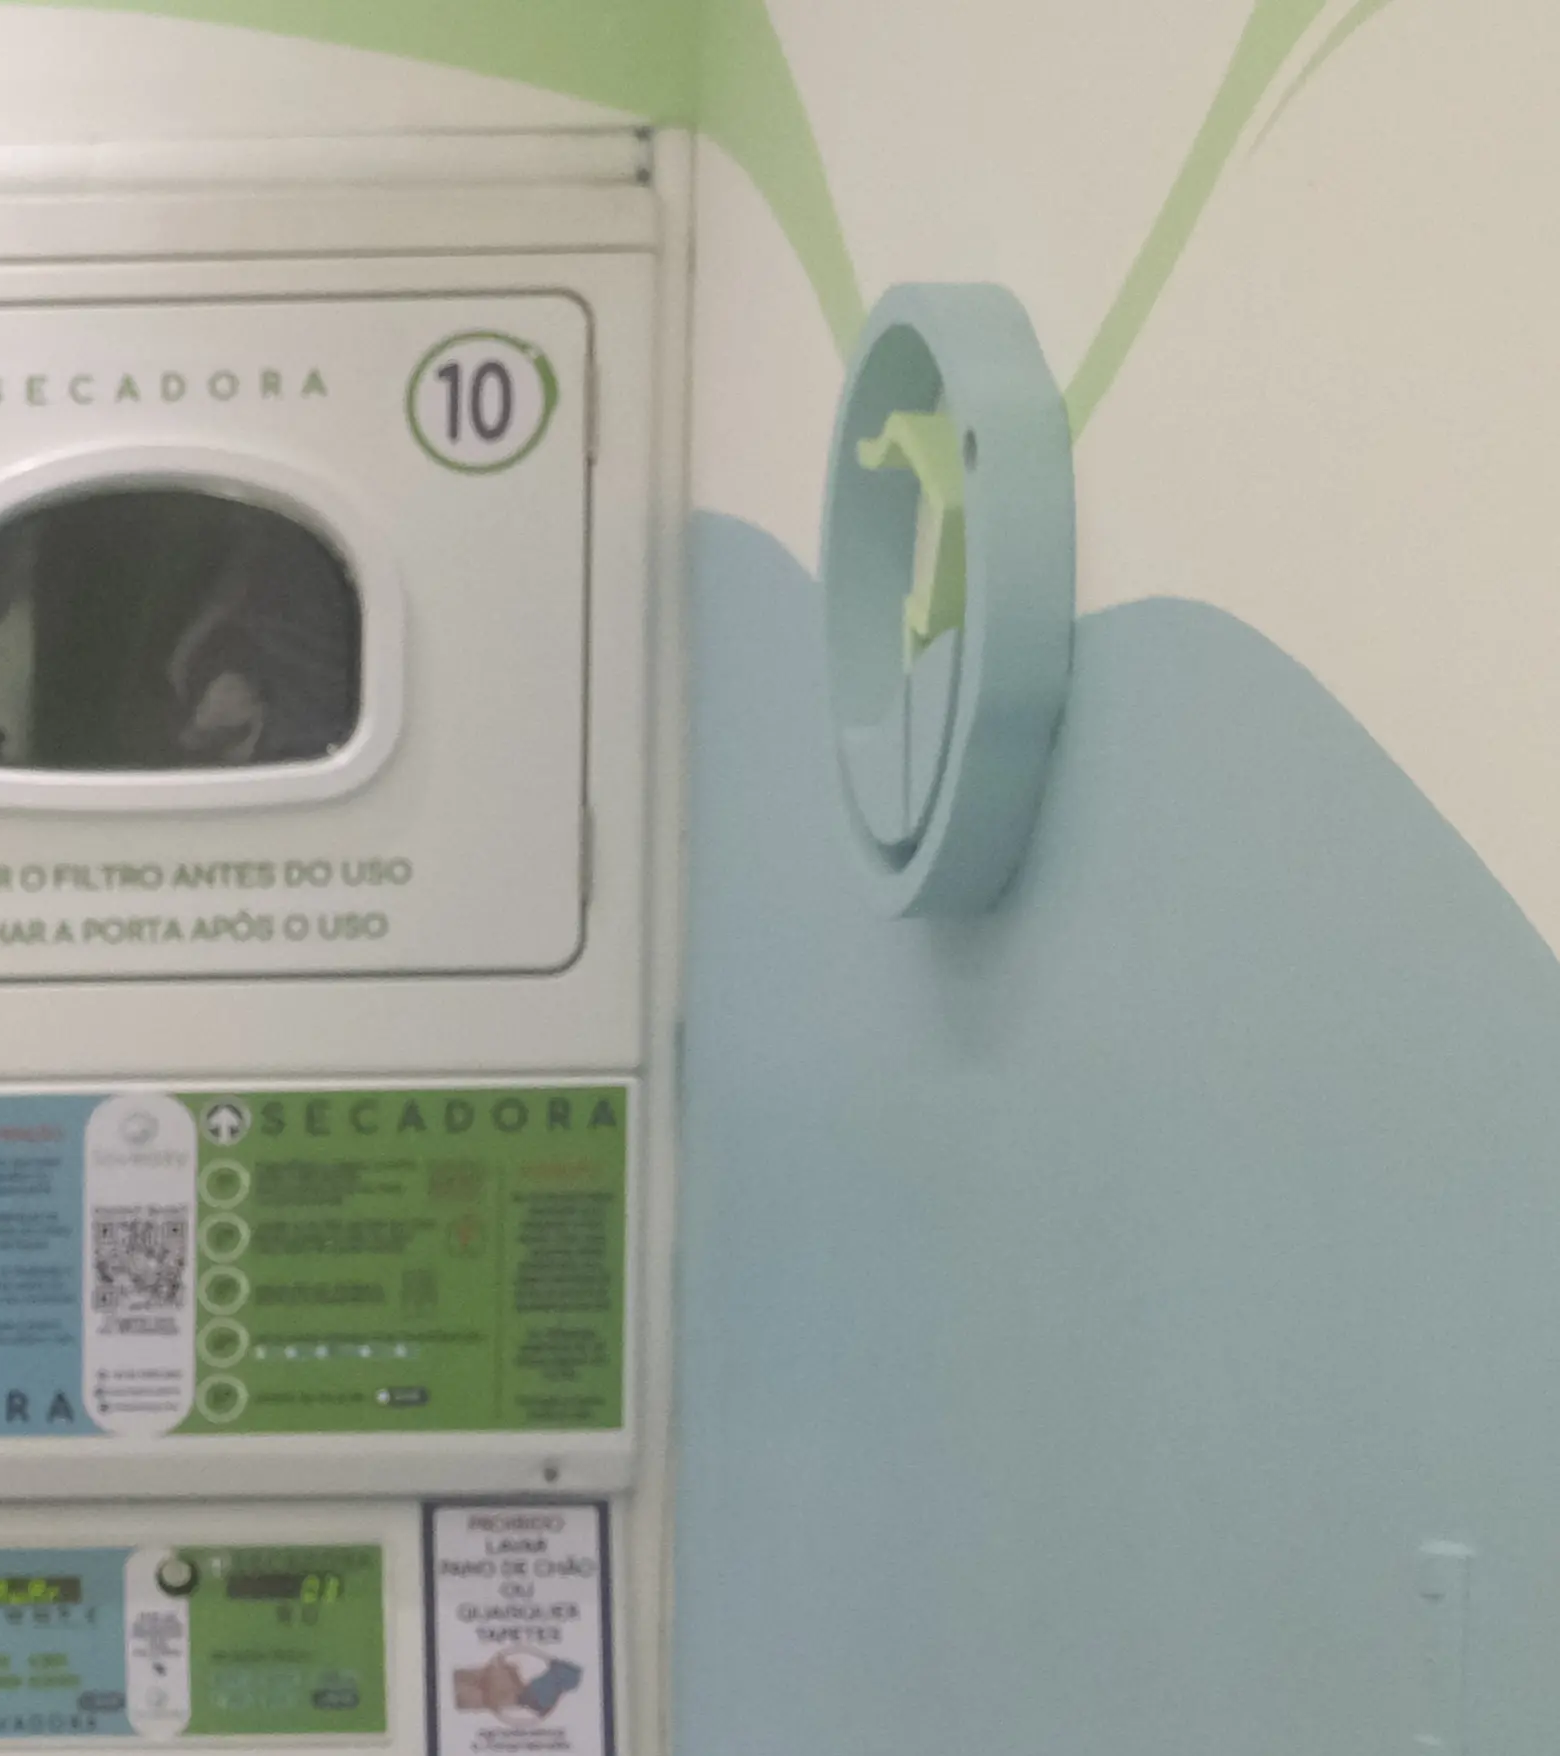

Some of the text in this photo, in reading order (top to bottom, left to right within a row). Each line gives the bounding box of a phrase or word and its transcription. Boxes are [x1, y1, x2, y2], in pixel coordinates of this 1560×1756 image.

[436, 359, 514, 445] 10
[20, 863, 46, 894] O
[52, 860, 164, 893] FILTRO
[172, 860, 277, 891] ANTES
[284, 859, 333, 889] DO
[340, 857, 413, 888] USO
[51, 918, 76, 946] A
[82, 914, 184, 945] PORTA
[191, 908, 275, 944] APÓS
[282, 912, 309, 943] O
[316, 911, 389, 942] USO
[260, 1096, 618, 1137] SECADORA
